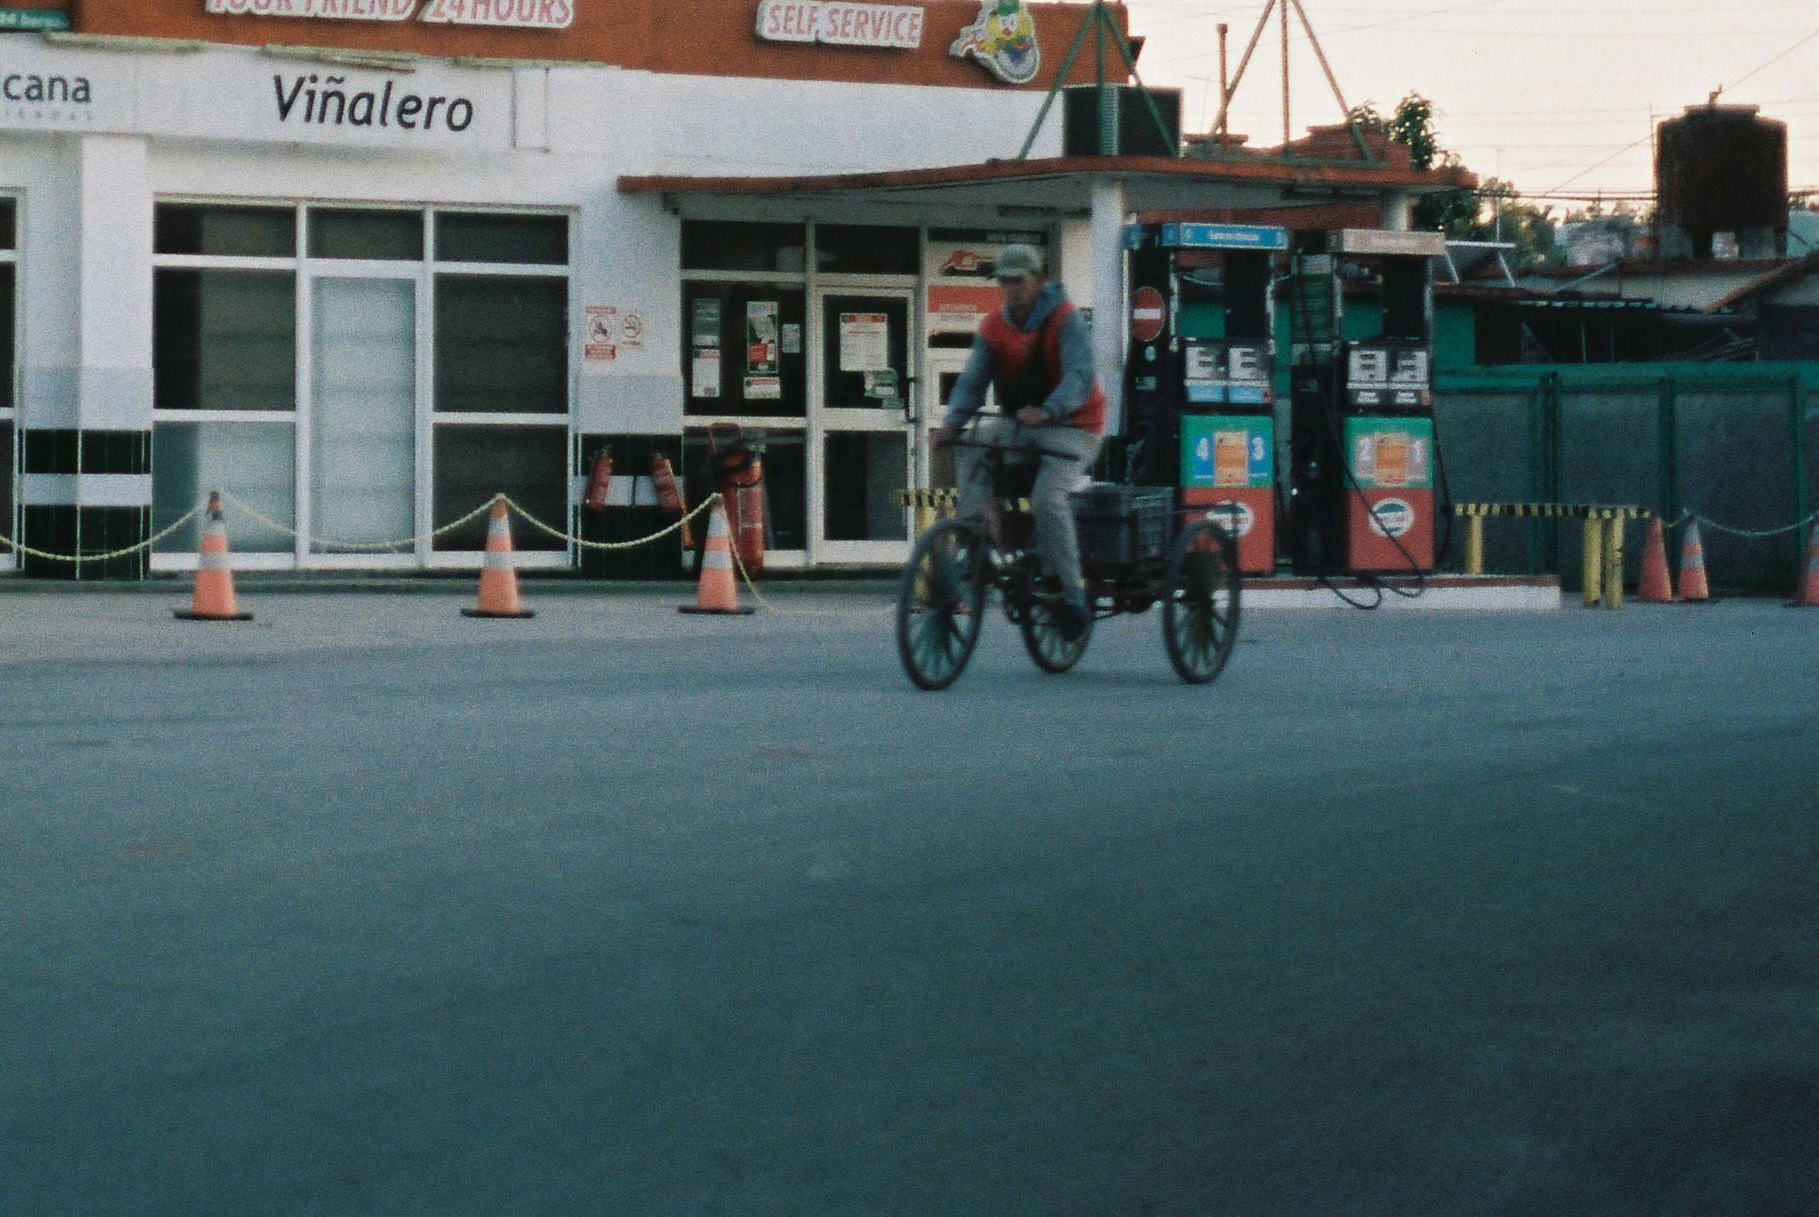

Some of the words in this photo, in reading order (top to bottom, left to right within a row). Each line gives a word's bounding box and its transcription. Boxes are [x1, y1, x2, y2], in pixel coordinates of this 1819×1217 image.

[767, 3, 818, 35] SELF
[824, 8, 921, 44] SERVICE
[273, 73, 473, 132] Viñalero
[1196, 437, 1209, 461] 4
[1251, 436, 1265, 461] 3
